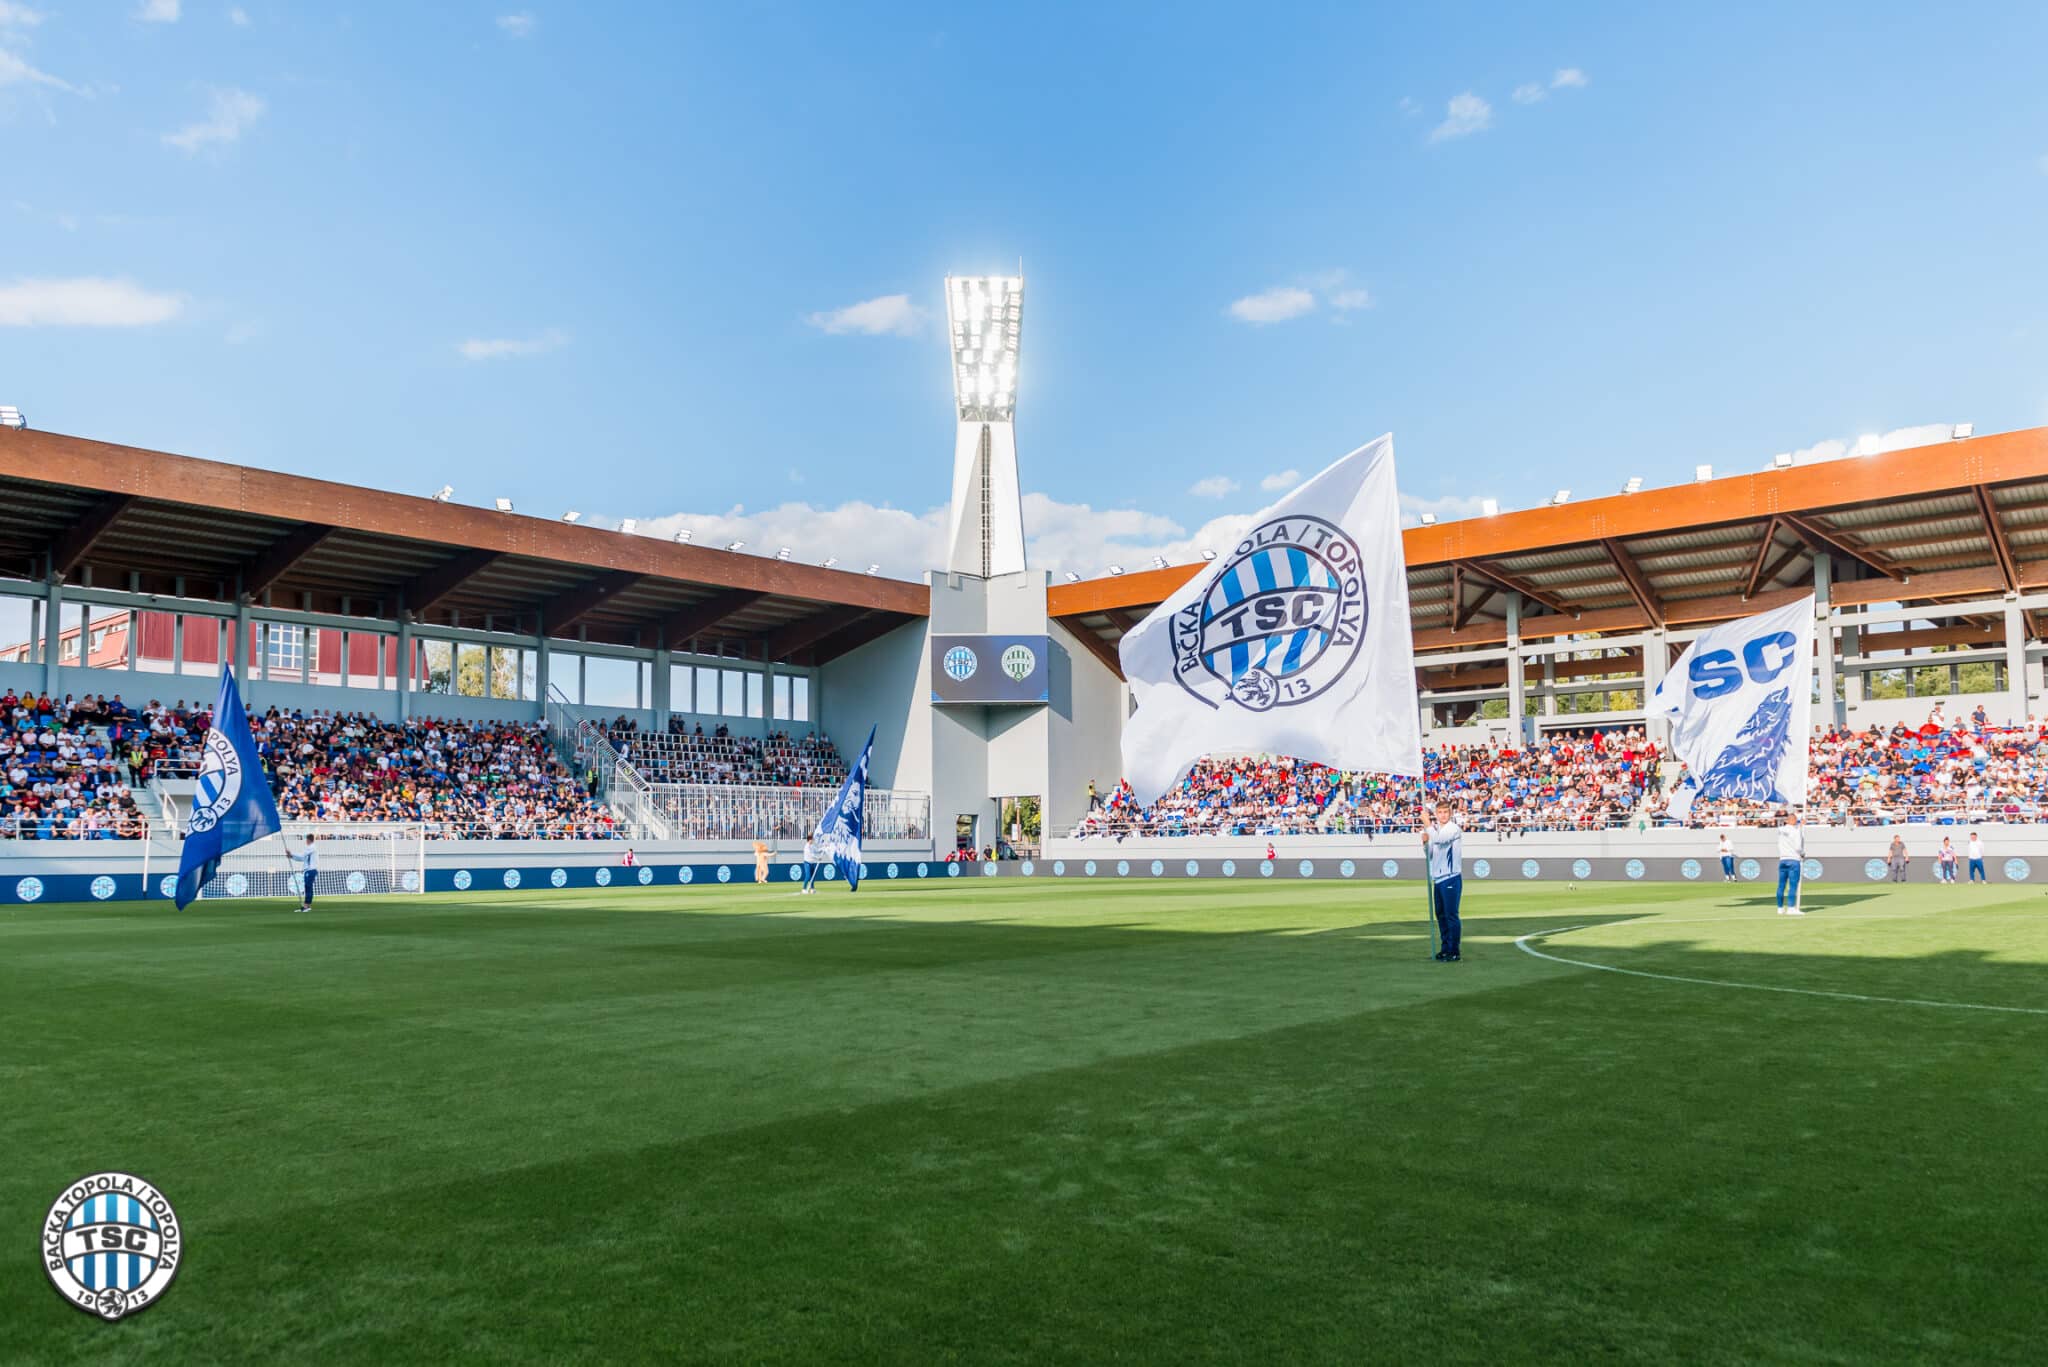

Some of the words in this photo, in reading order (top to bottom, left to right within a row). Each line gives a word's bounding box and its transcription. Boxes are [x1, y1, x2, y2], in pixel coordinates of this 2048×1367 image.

[1314, 527, 1361, 646] TOPOLYA
[1220, 593, 1324, 638] TSC
[1284, 678, 1311, 698] 13
[1655, 631, 1797, 712] SC
[216, 797, 231, 811] 13
